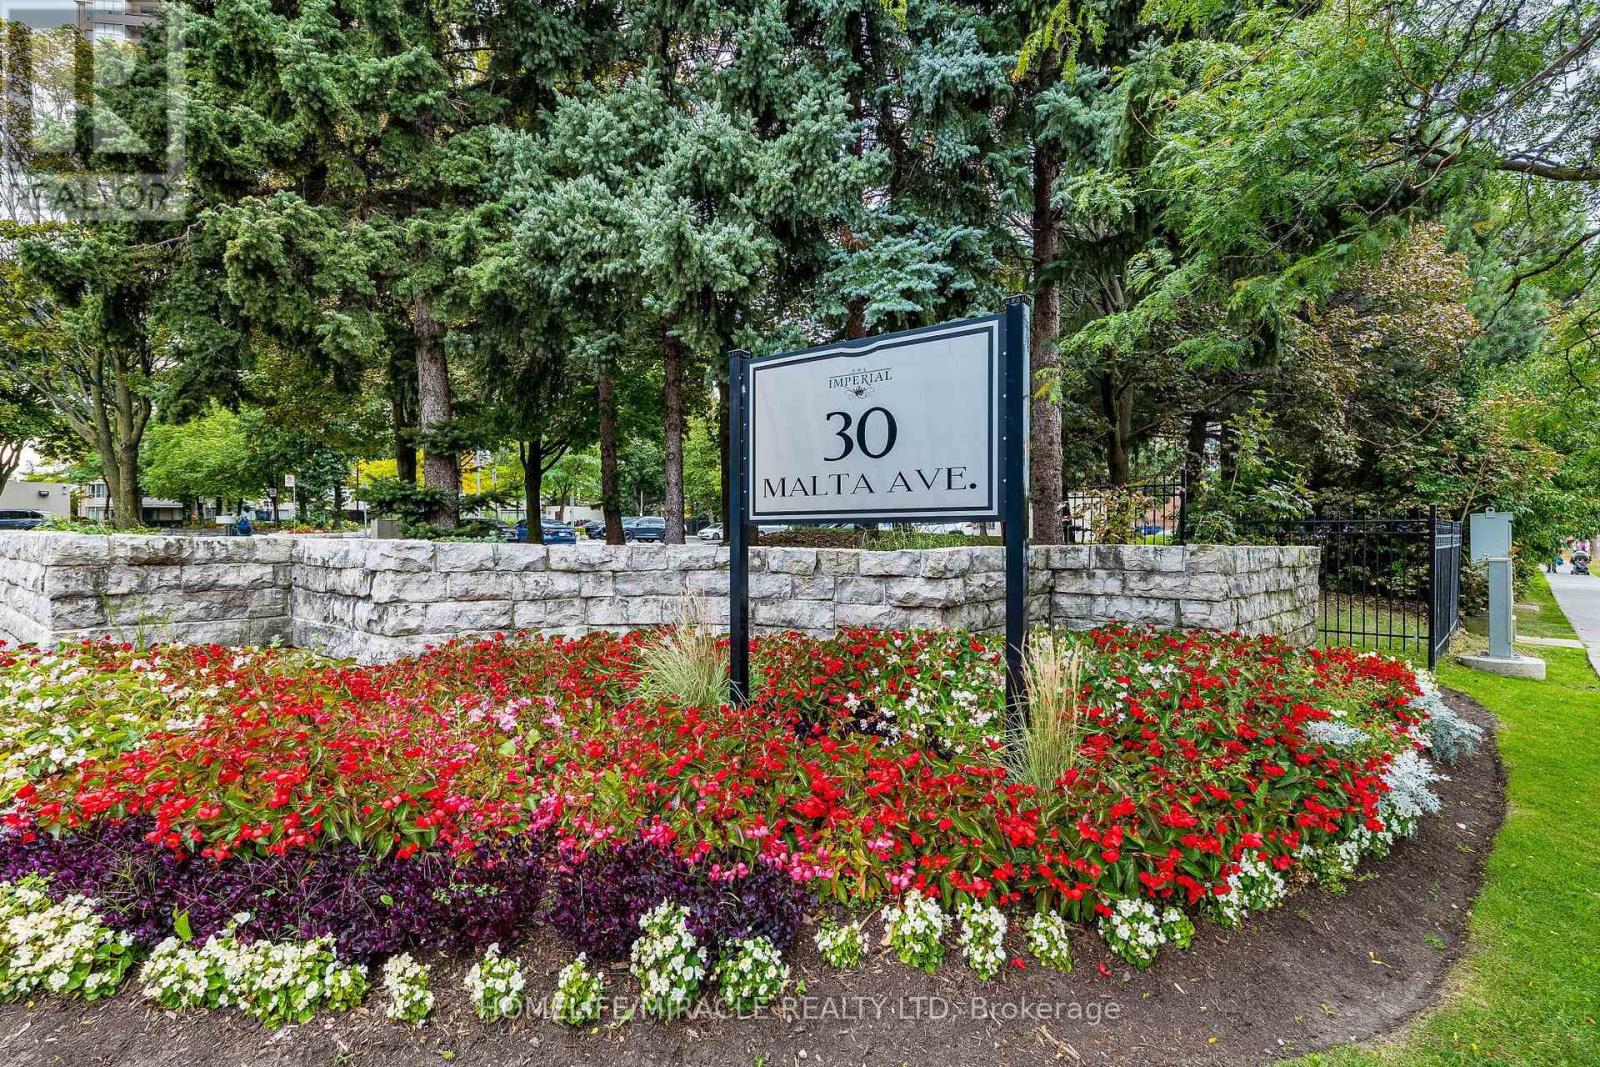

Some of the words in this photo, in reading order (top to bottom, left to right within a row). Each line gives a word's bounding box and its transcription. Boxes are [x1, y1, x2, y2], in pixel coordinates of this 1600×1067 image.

[828, 371, 893, 388] IMPERIAL
[824, 407, 897, 461] 30
[763, 473, 875, 498] MALTA
[886, 466, 977, 493] AVE.
